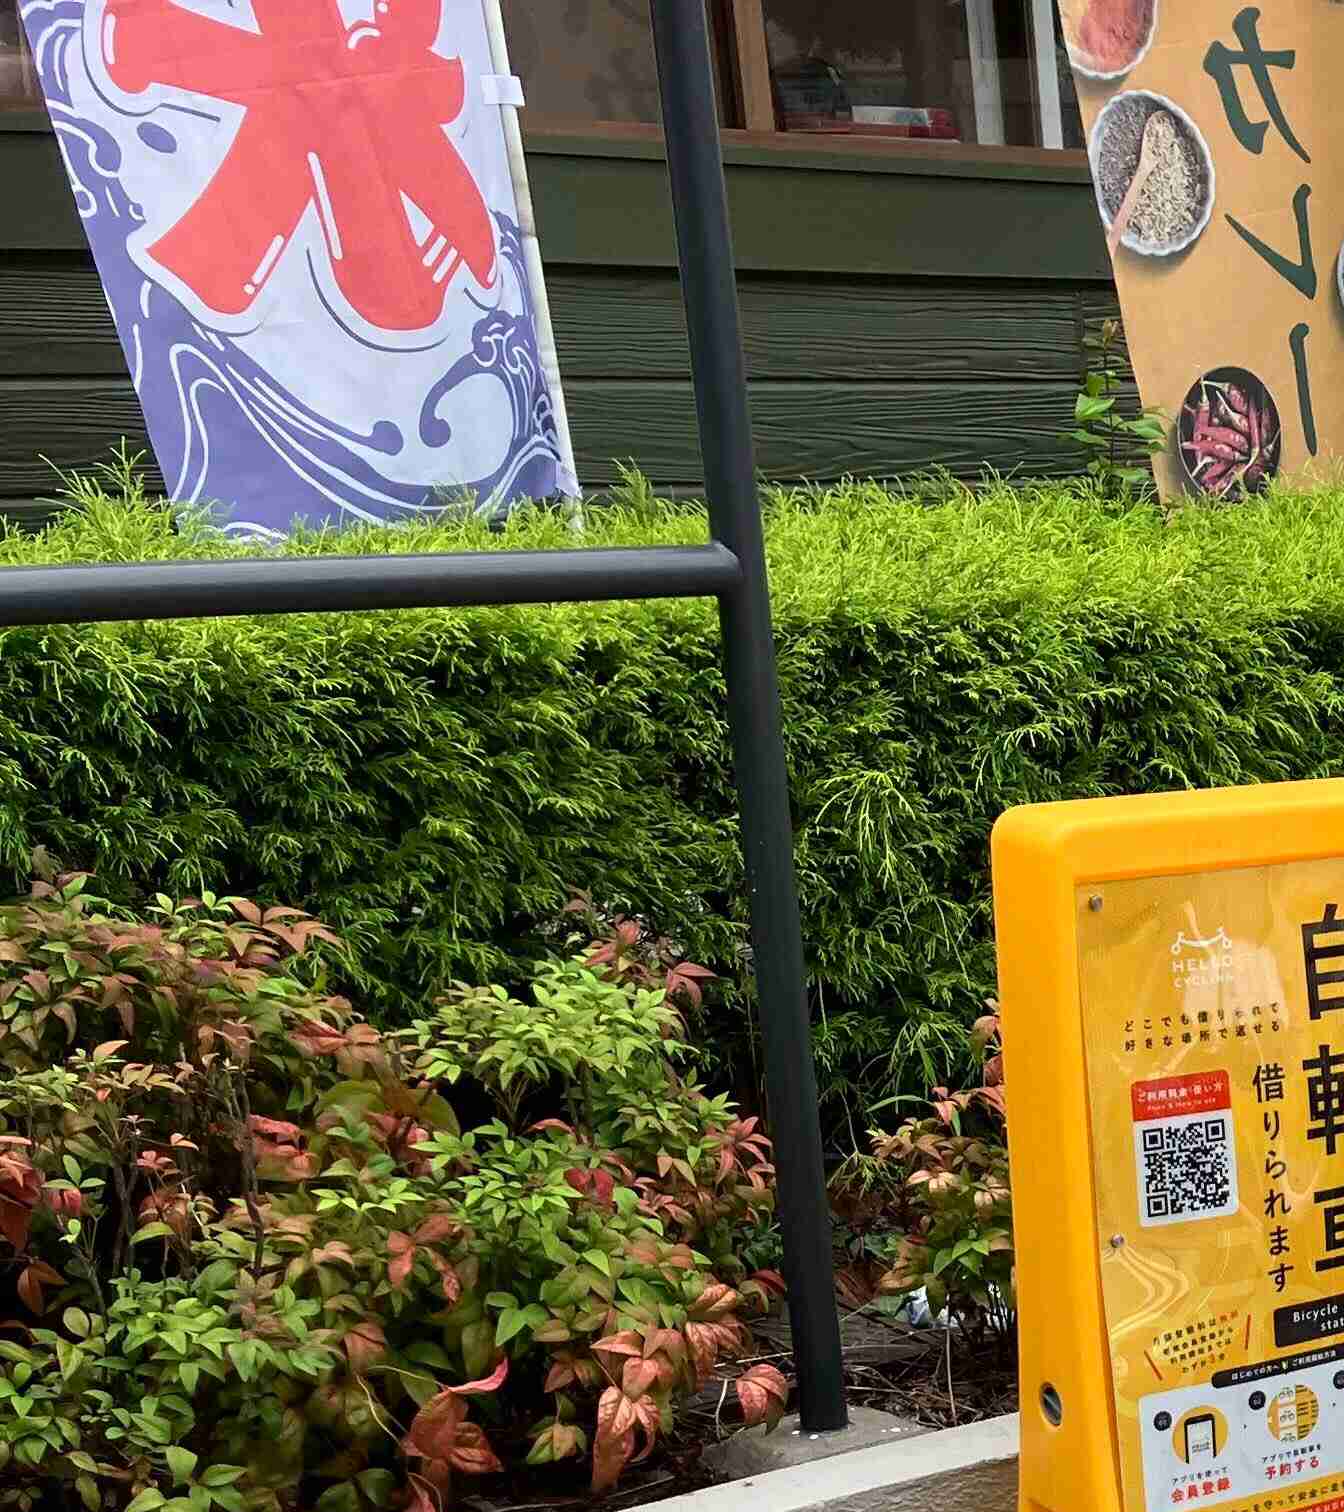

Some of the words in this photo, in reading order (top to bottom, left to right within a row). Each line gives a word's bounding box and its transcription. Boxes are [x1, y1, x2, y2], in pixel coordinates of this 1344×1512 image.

[1171, 956, 1233, 973] HELLO
[1252, 1063, 1294, 1293] 借りられます
[1293, 1303, 1339, 1323] Bicycle
[1264, 1455, 1320, 1480] 予約する
[1171, 1477, 1231, 1503] 会員登録
